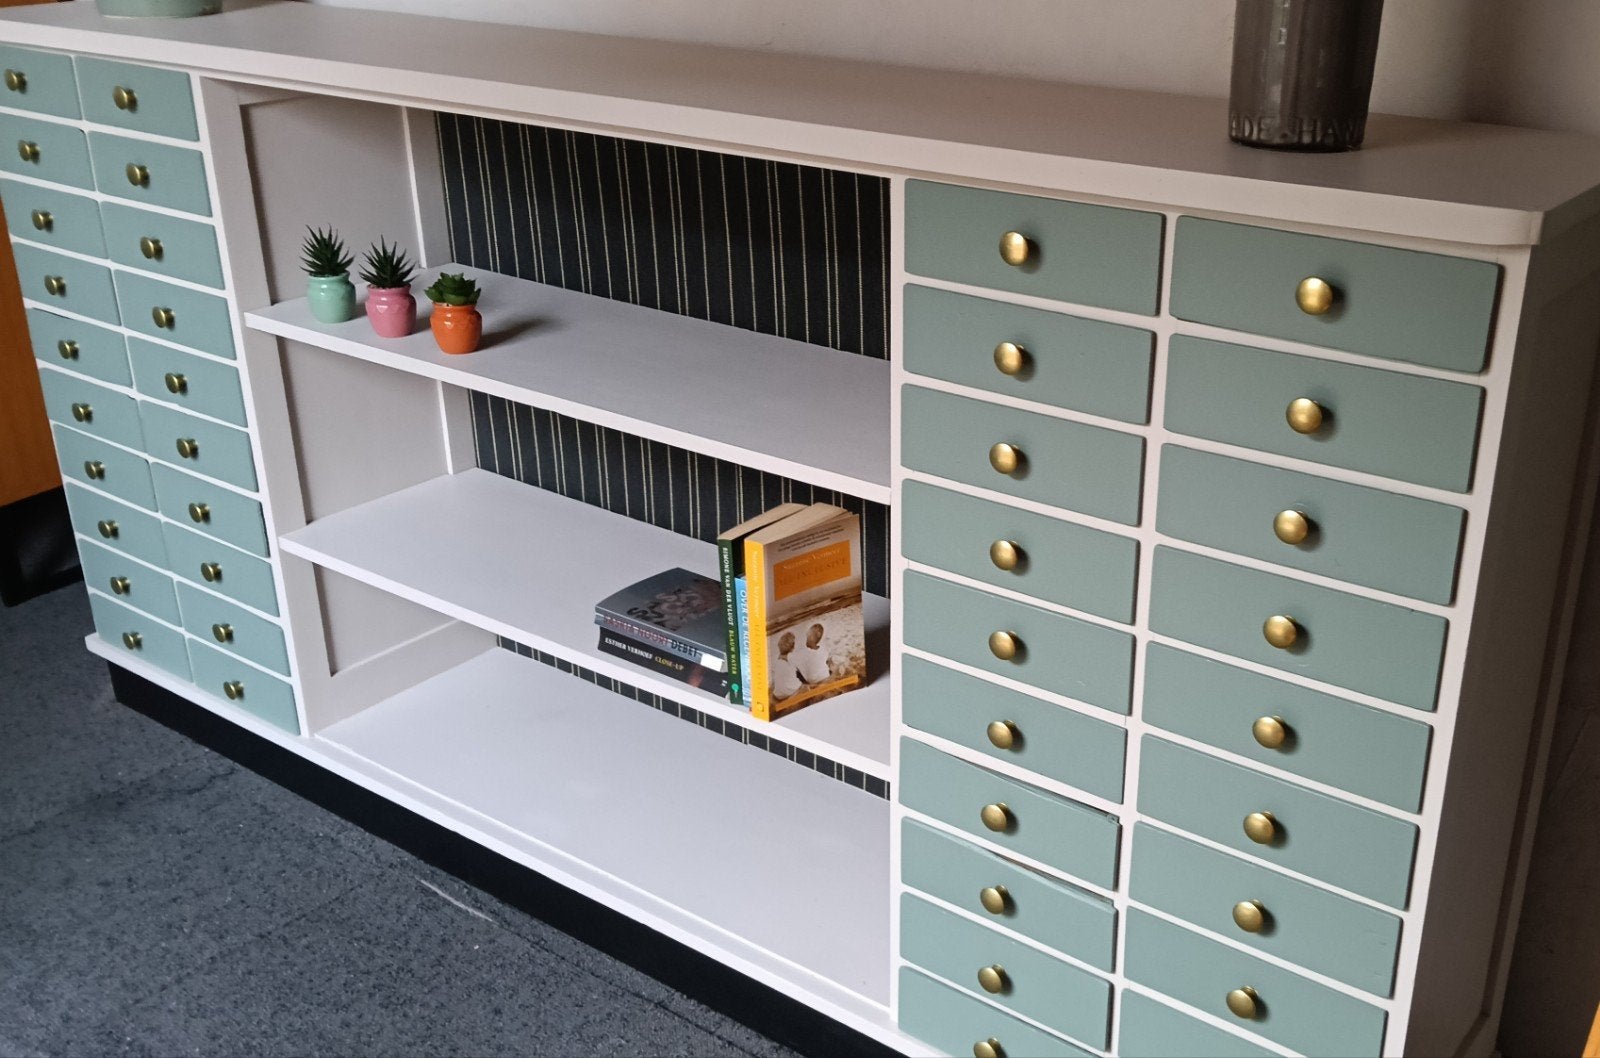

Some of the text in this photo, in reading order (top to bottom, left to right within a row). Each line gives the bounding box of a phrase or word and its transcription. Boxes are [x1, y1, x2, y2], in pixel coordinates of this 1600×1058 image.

[722, 547, 730, 573] SIMONE
[740, 589, 748, 613] OVER
[726, 604, 734, 626] VLUGT
[671, 640, 699, 657] DEBET
[728, 629, 736, 652] BLAUW
[604, 637, 627, 651] ESTHER
[654, 656, 685, 671] CLOSE-UP
